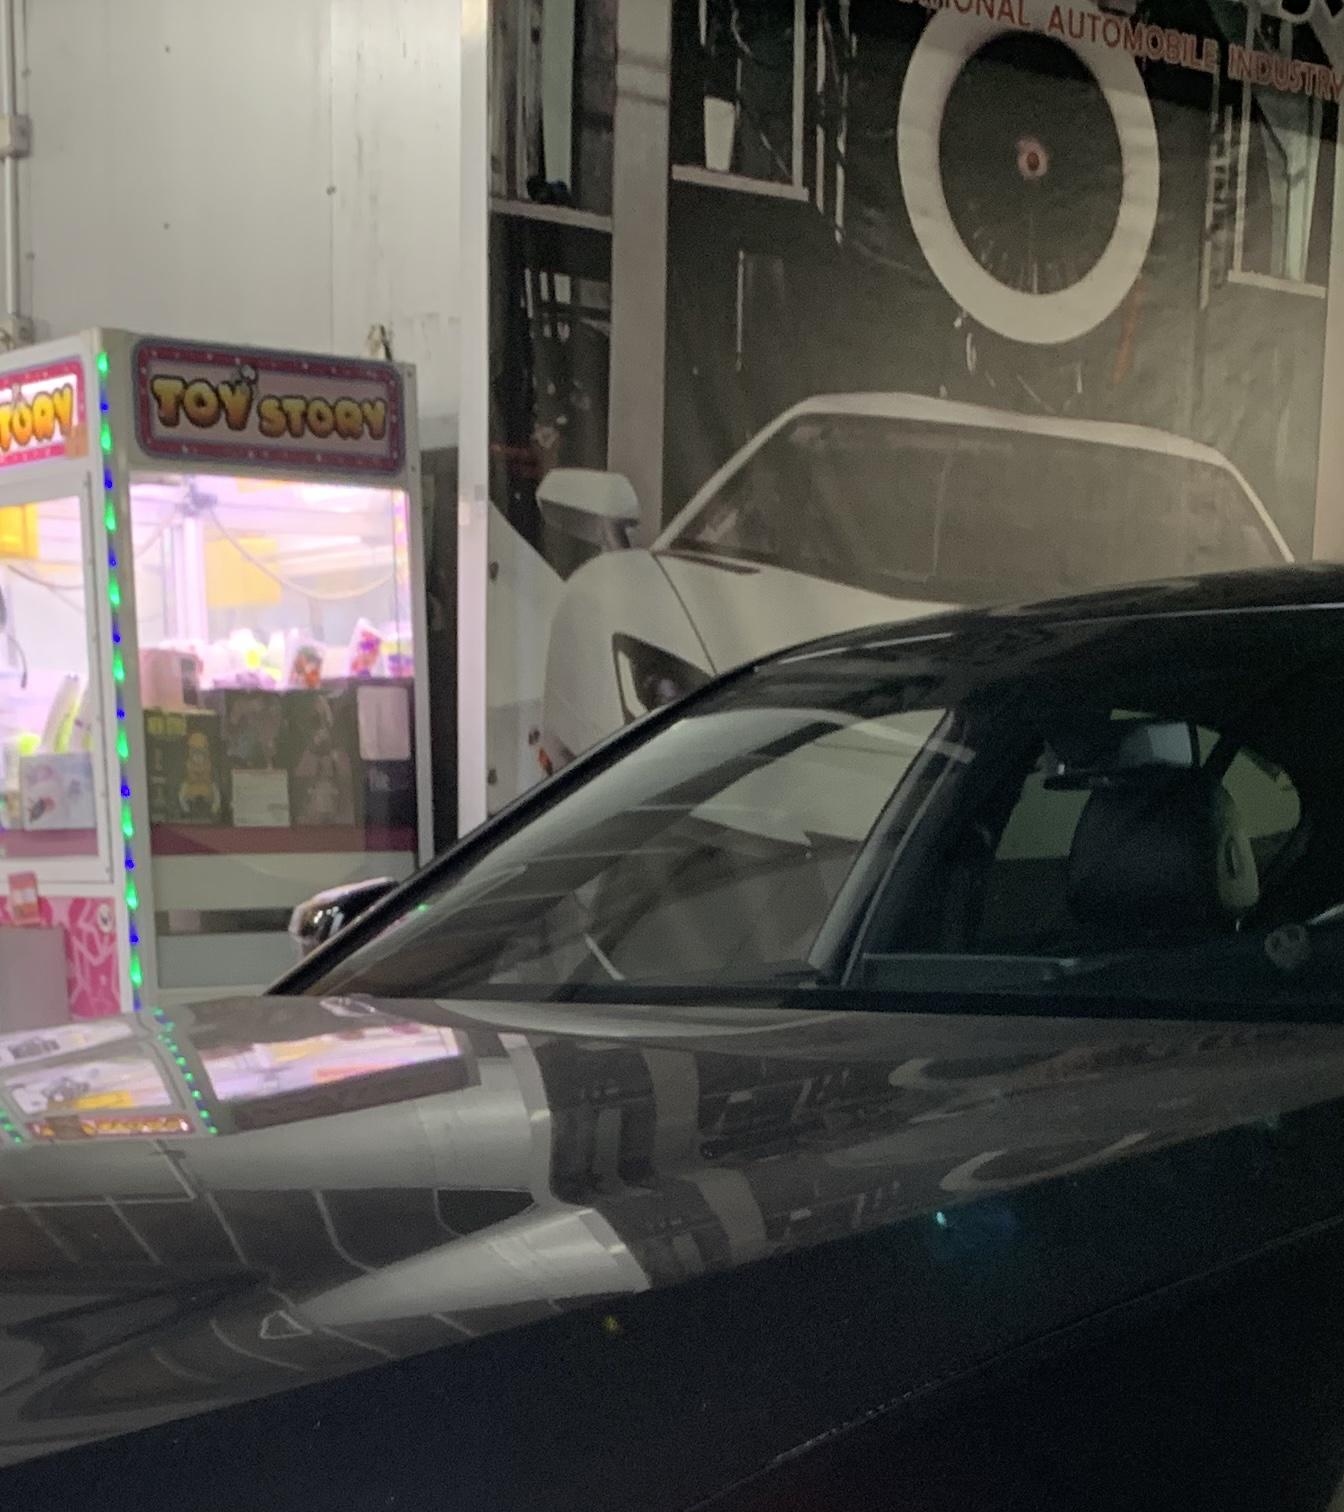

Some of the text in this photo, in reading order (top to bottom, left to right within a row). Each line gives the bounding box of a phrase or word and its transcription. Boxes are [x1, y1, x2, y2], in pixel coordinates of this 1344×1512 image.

[1047, 7, 1219, 73] AUTOMOBILE
[150, 374, 387, 441] TOY STORY
